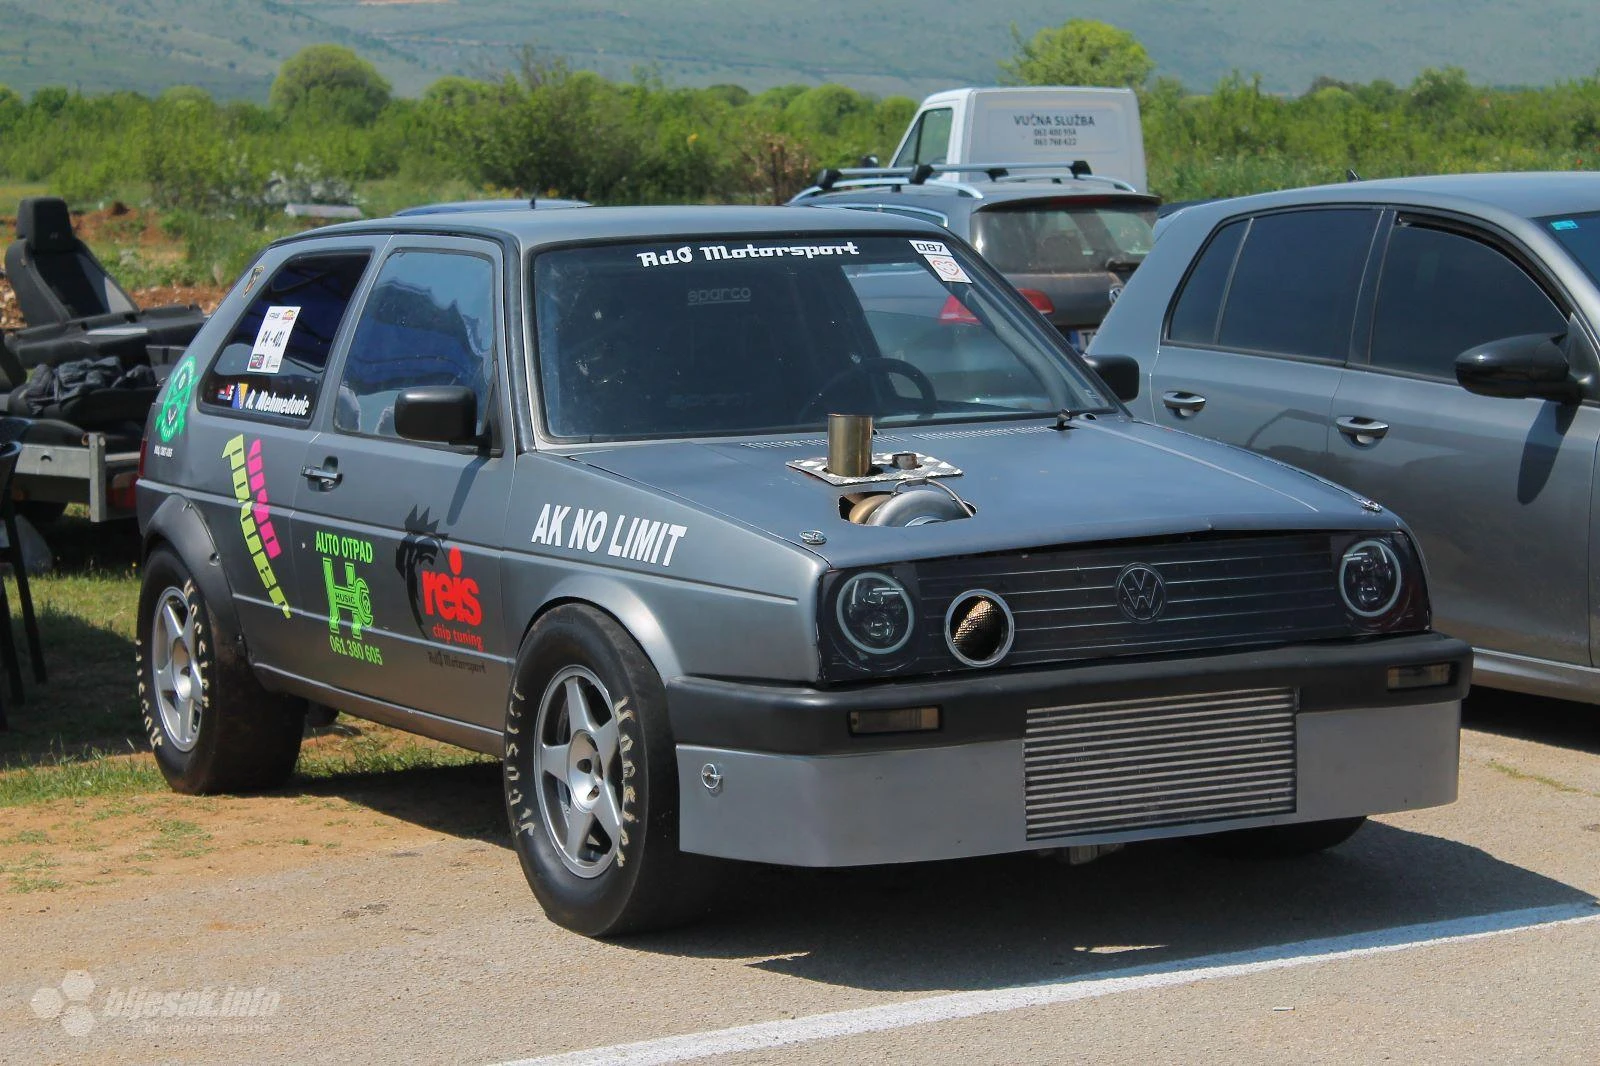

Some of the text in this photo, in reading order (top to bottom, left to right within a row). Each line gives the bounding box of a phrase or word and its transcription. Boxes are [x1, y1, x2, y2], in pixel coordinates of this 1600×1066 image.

[700, 242, 859, 259] Motorsport
[315, 531, 373, 564] AUTO OTPAD
[531, 503, 688, 567] AK NO LIMIT
[422, 547, 482, 626] reis
[432, 624, 484, 652] chip tuning
